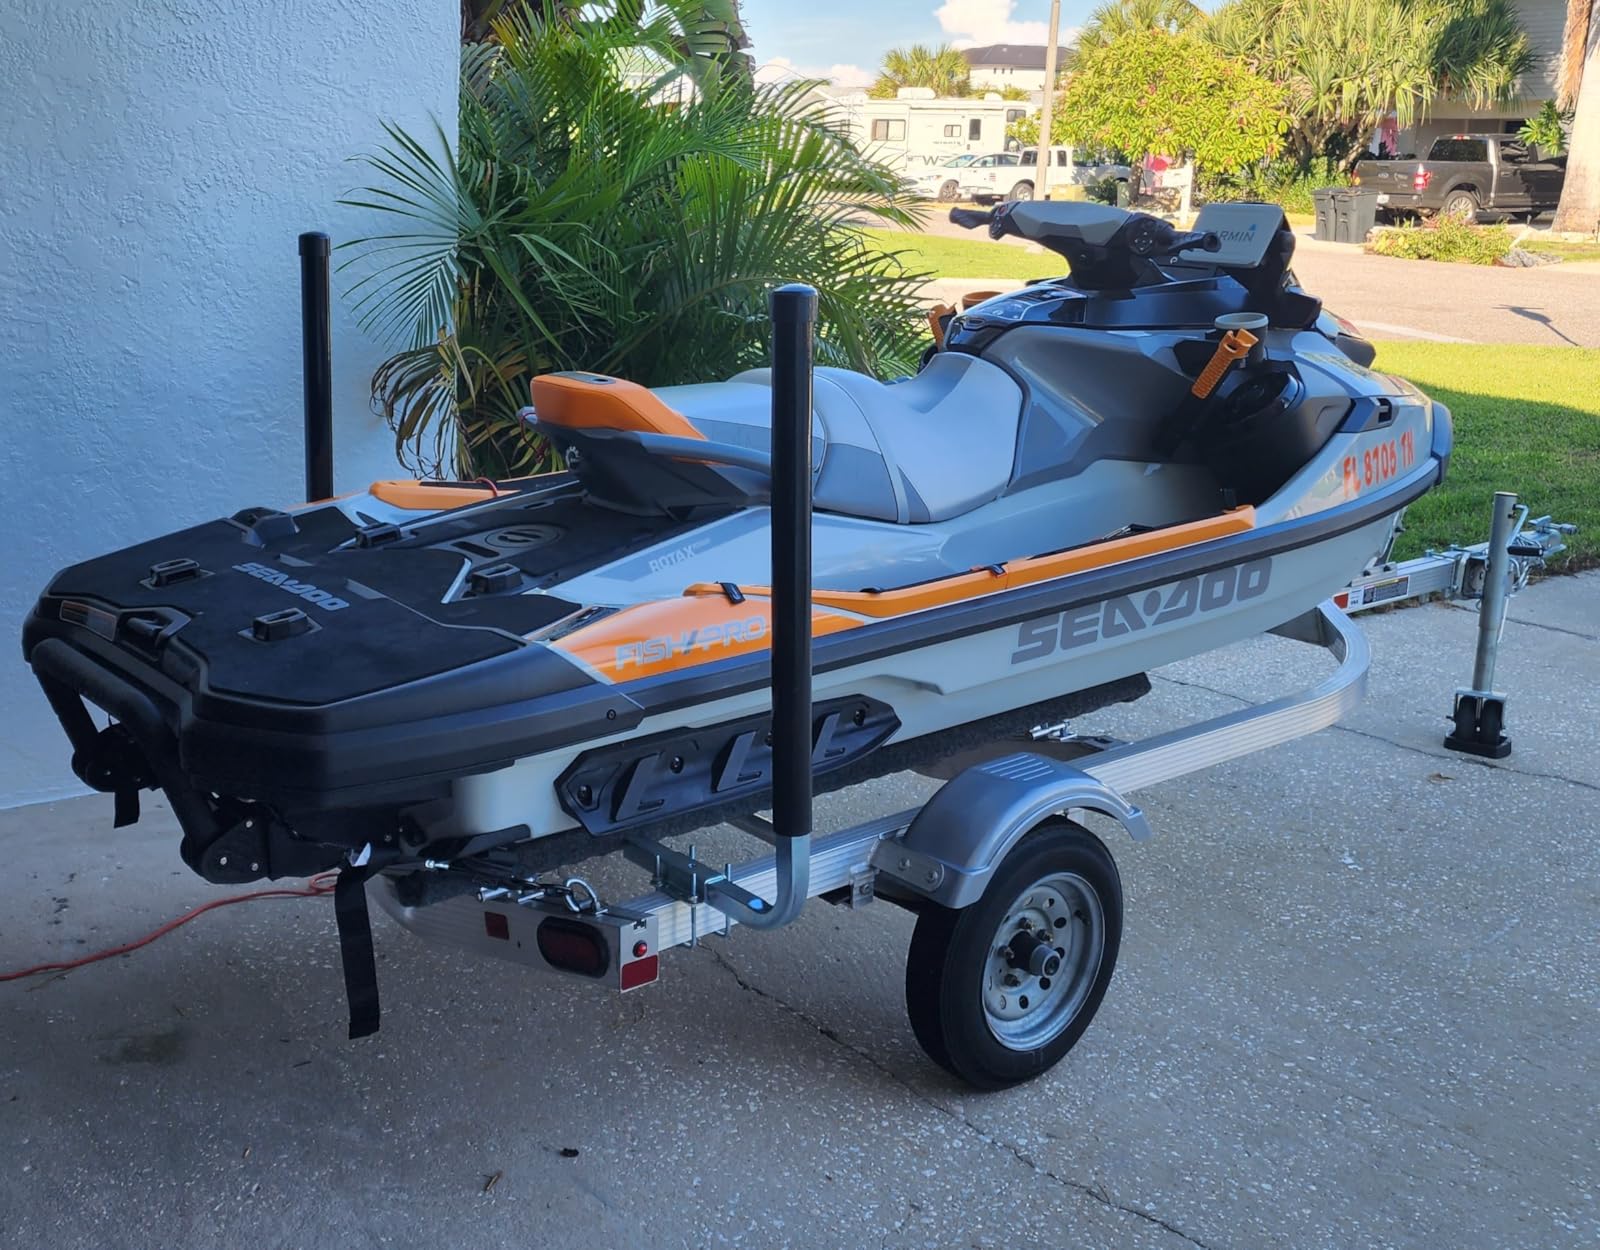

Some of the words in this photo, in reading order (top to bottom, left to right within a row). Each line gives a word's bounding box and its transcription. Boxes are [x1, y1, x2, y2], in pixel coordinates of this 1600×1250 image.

[1215, 230, 1255, 242] RMIN
[1343, 455, 1361, 498] FL
[648, 545, 696, 576] ROTAX
